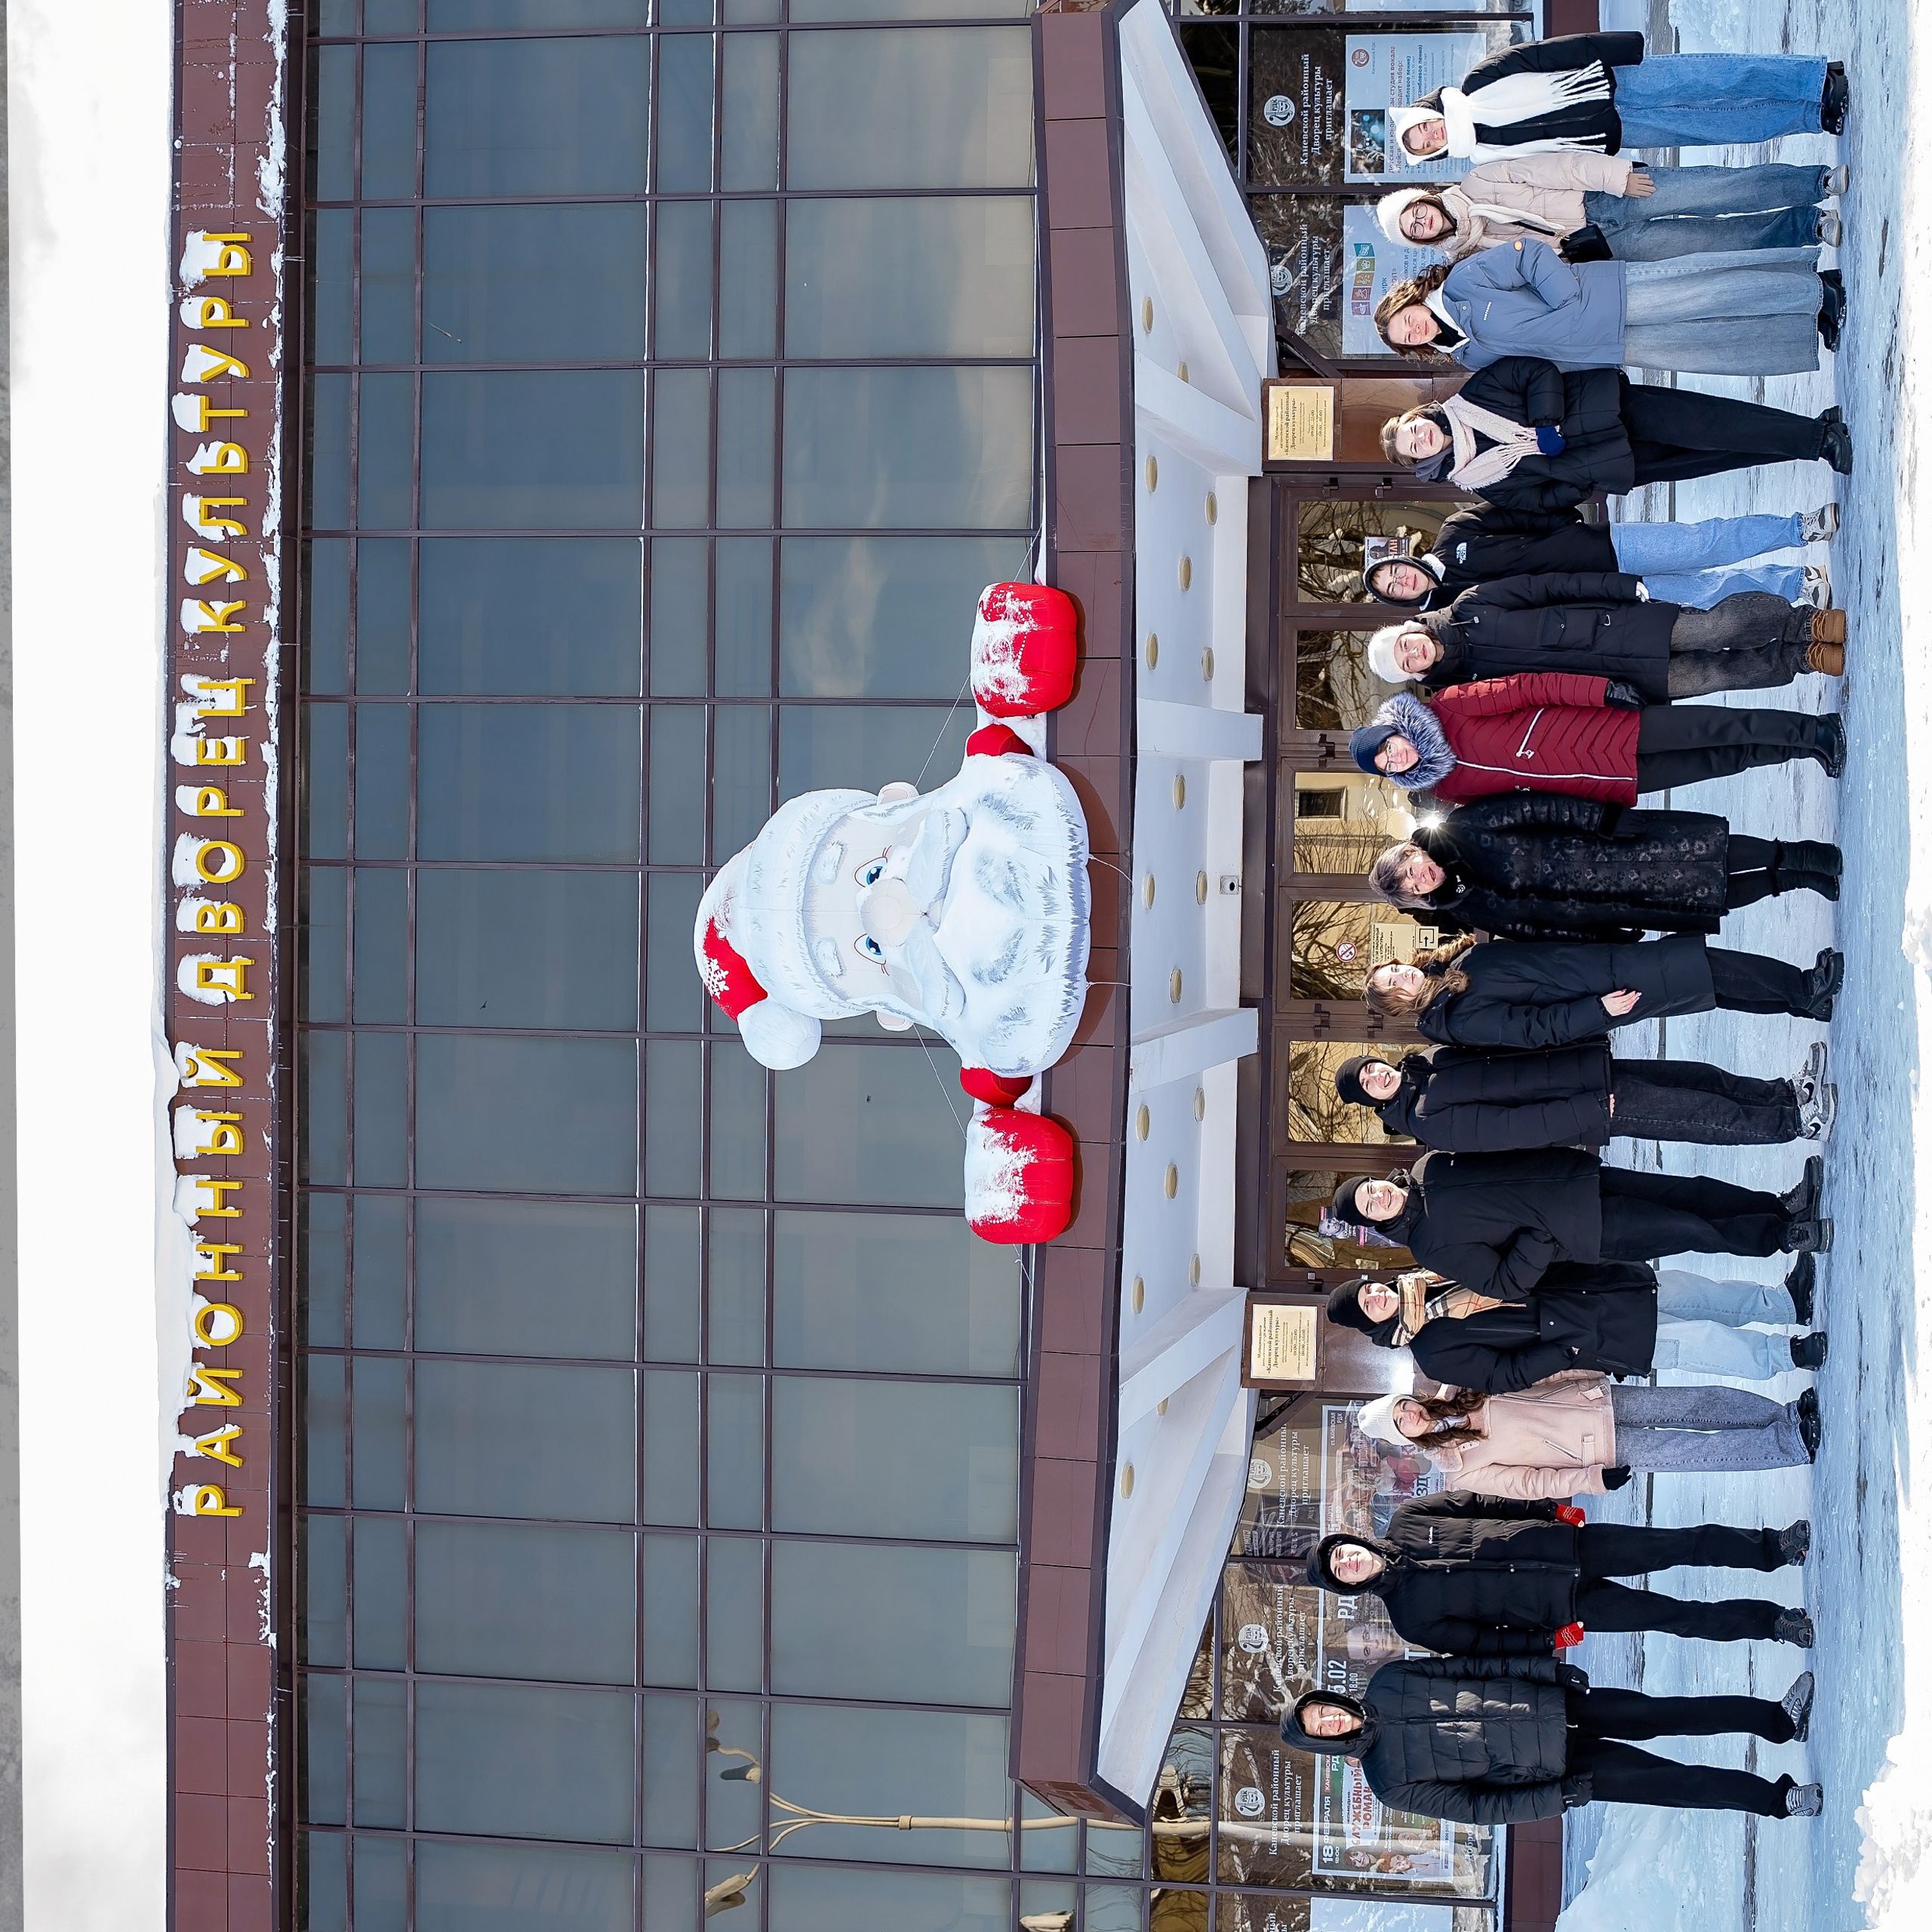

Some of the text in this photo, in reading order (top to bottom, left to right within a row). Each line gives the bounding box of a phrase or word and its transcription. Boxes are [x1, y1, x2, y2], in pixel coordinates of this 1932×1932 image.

[1300, 54, 1311, 165] Каневской районный
[1312, 66, 1324, 155] Дворец культуры
[1324, 78, 1334, 140] приглашает
[1298, 223, 1310, 334] Каневской районный
[1309, 235, 1321, 323] Дворец культуры
[1322, 249, 1331, 311] приглашает
[187, 232, 254, 1517] РАЙОННЫЙ ДВОРЕЦ КУЛЬТУРЫ
[1276, 1423, 1289, 1527] Каневской районны
[1289, 1432, 1300, 1517] Дворец культуры
[1301, 1444, 1310, 1505] приглашает
[1416, 1477, 1431, 1496] ЗД
[1273, 1585, 1286, 1692] Каневской районный
[1286, 1597, 1298, 1682] Дворец культуры
[1298, 1611, 1307, 1669] приглашает
[1327, 1595, 1358, 1694] 5.02 РД
[1349, 1672, 1358, 1692] 18:00
[1269, 1749, 1281, 1855] Каневской районный
[1281, 1761, 1292, 1845] Дворец культуры
[1331, 1755, 1340, 1771] РД
[1294, 1774, 1303, 1833] приглашает
[1351, 1769, 1361, 1846] СЛУЖЕБНЫЙ
[1363, 1786, 1372, 1829] РОМАН
[1323, 1845, 1334, 1864] 18
[1464, 1831, 1475, 1861] Добро
